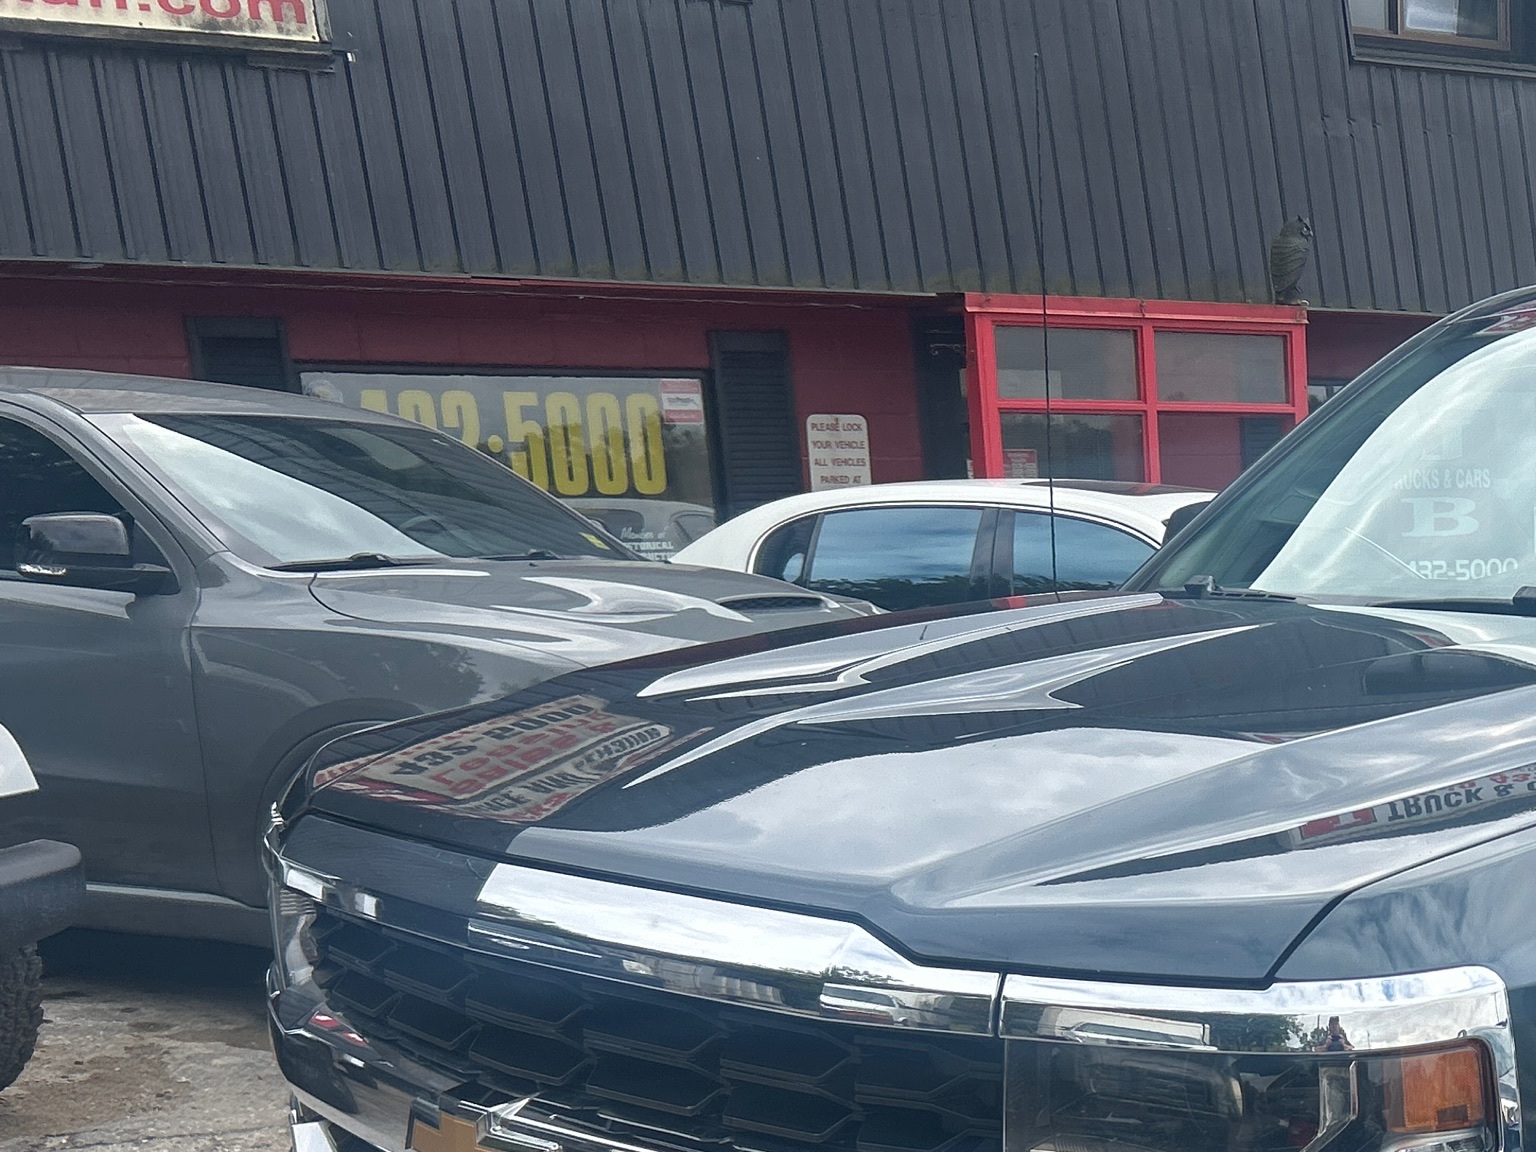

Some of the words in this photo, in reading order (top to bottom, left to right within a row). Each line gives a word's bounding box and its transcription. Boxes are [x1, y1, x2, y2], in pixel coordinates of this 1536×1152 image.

[811, 422, 840, 432] PLEASE
[842, 423, 863, 432] LOCK
[811, 440, 832, 449] YOUR
[834, 440, 866, 449] VEHICLE
[814, 458, 828, 467] ALL
[831, 458, 866, 467] VEHICLES
[820, 475, 850, 484] PARKED
[852, 475, 862, 484] AT
[1444, 469, 1452, 488] &
[1456, 468, 1491, 489] CARS
[1400, 497, 1479, 537] B
